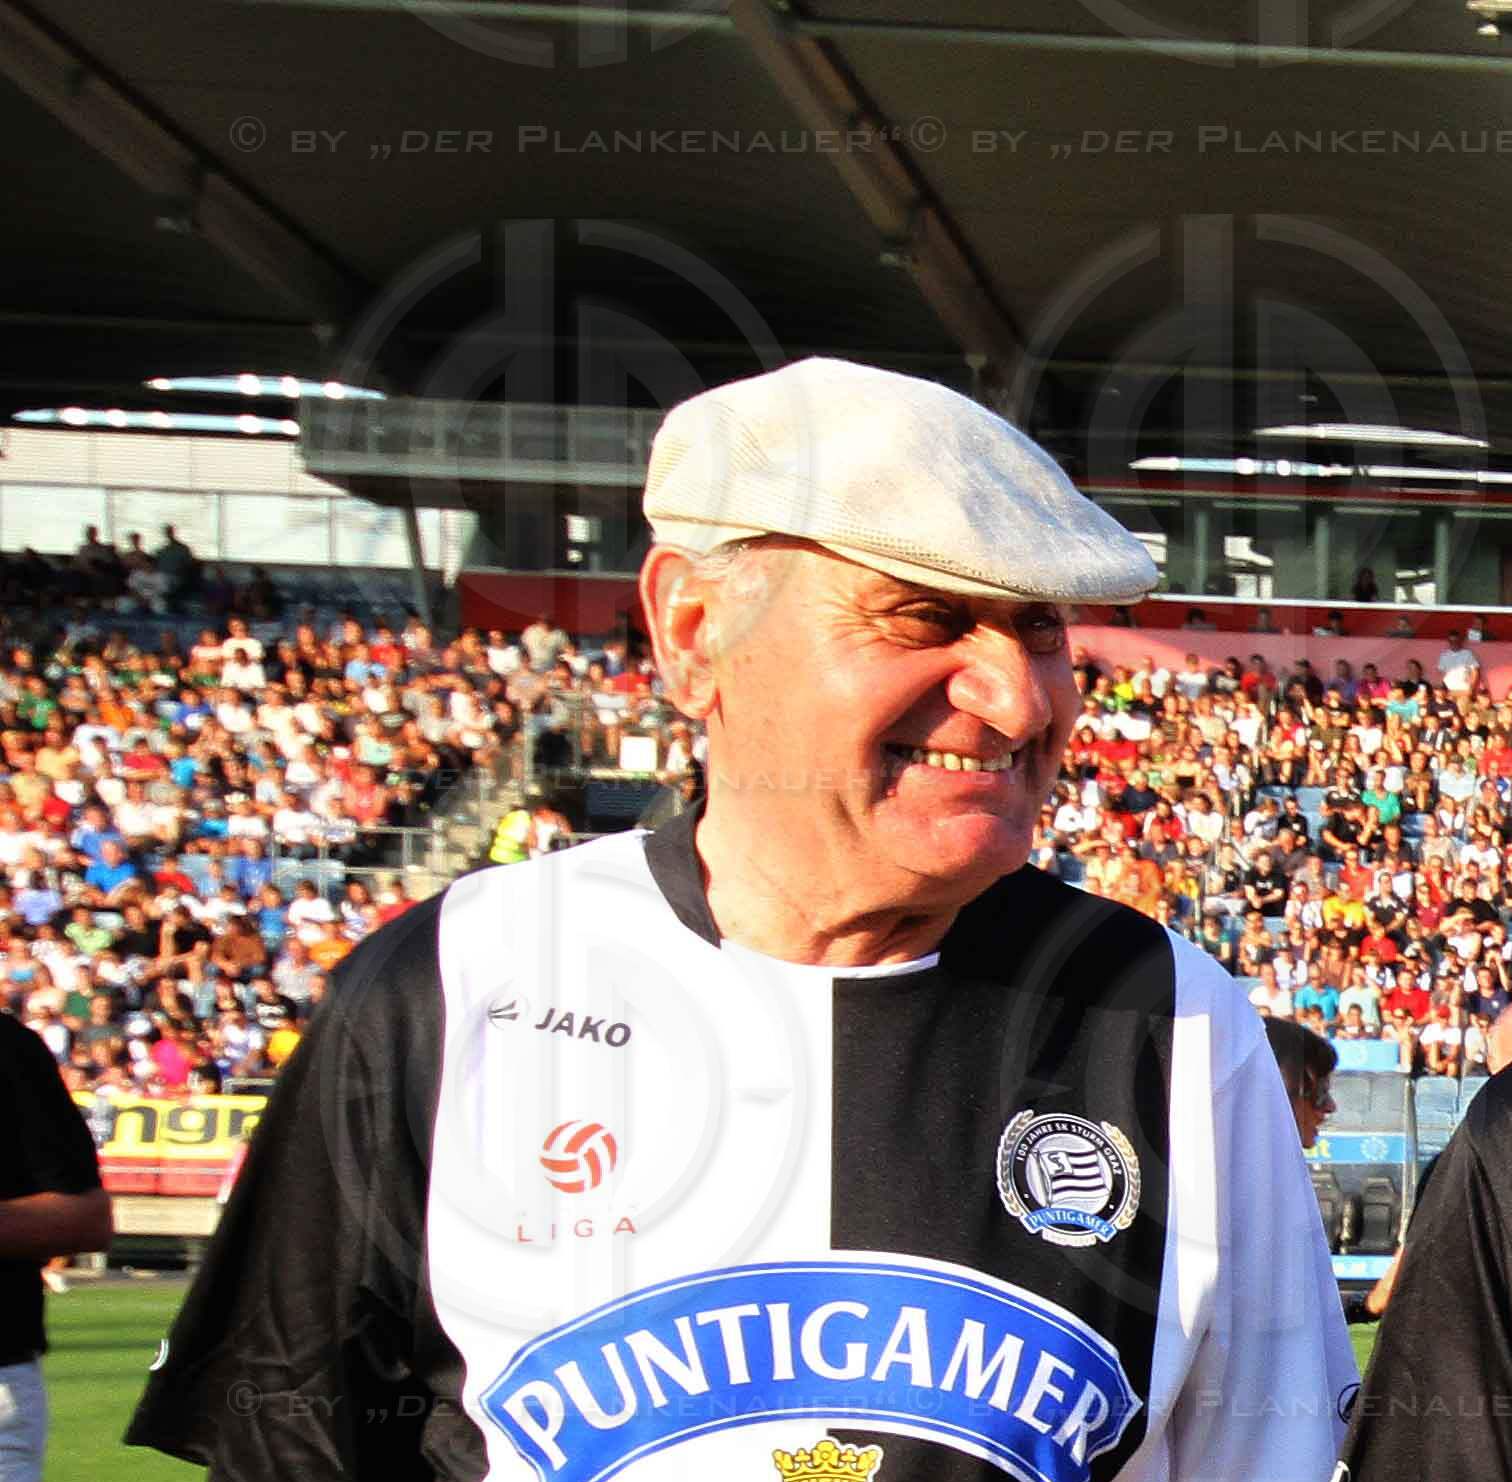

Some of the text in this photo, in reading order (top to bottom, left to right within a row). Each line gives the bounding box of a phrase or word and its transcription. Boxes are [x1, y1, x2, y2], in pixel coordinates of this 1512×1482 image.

[535, 1006, 632, 1049] JAKO
[517, 1215, 638, 1244] LIGA
[1029, 1211, 1111, 1234] PUNTIGAMER
[502, 1302, 1106, 1470] PUNTIGAMER
